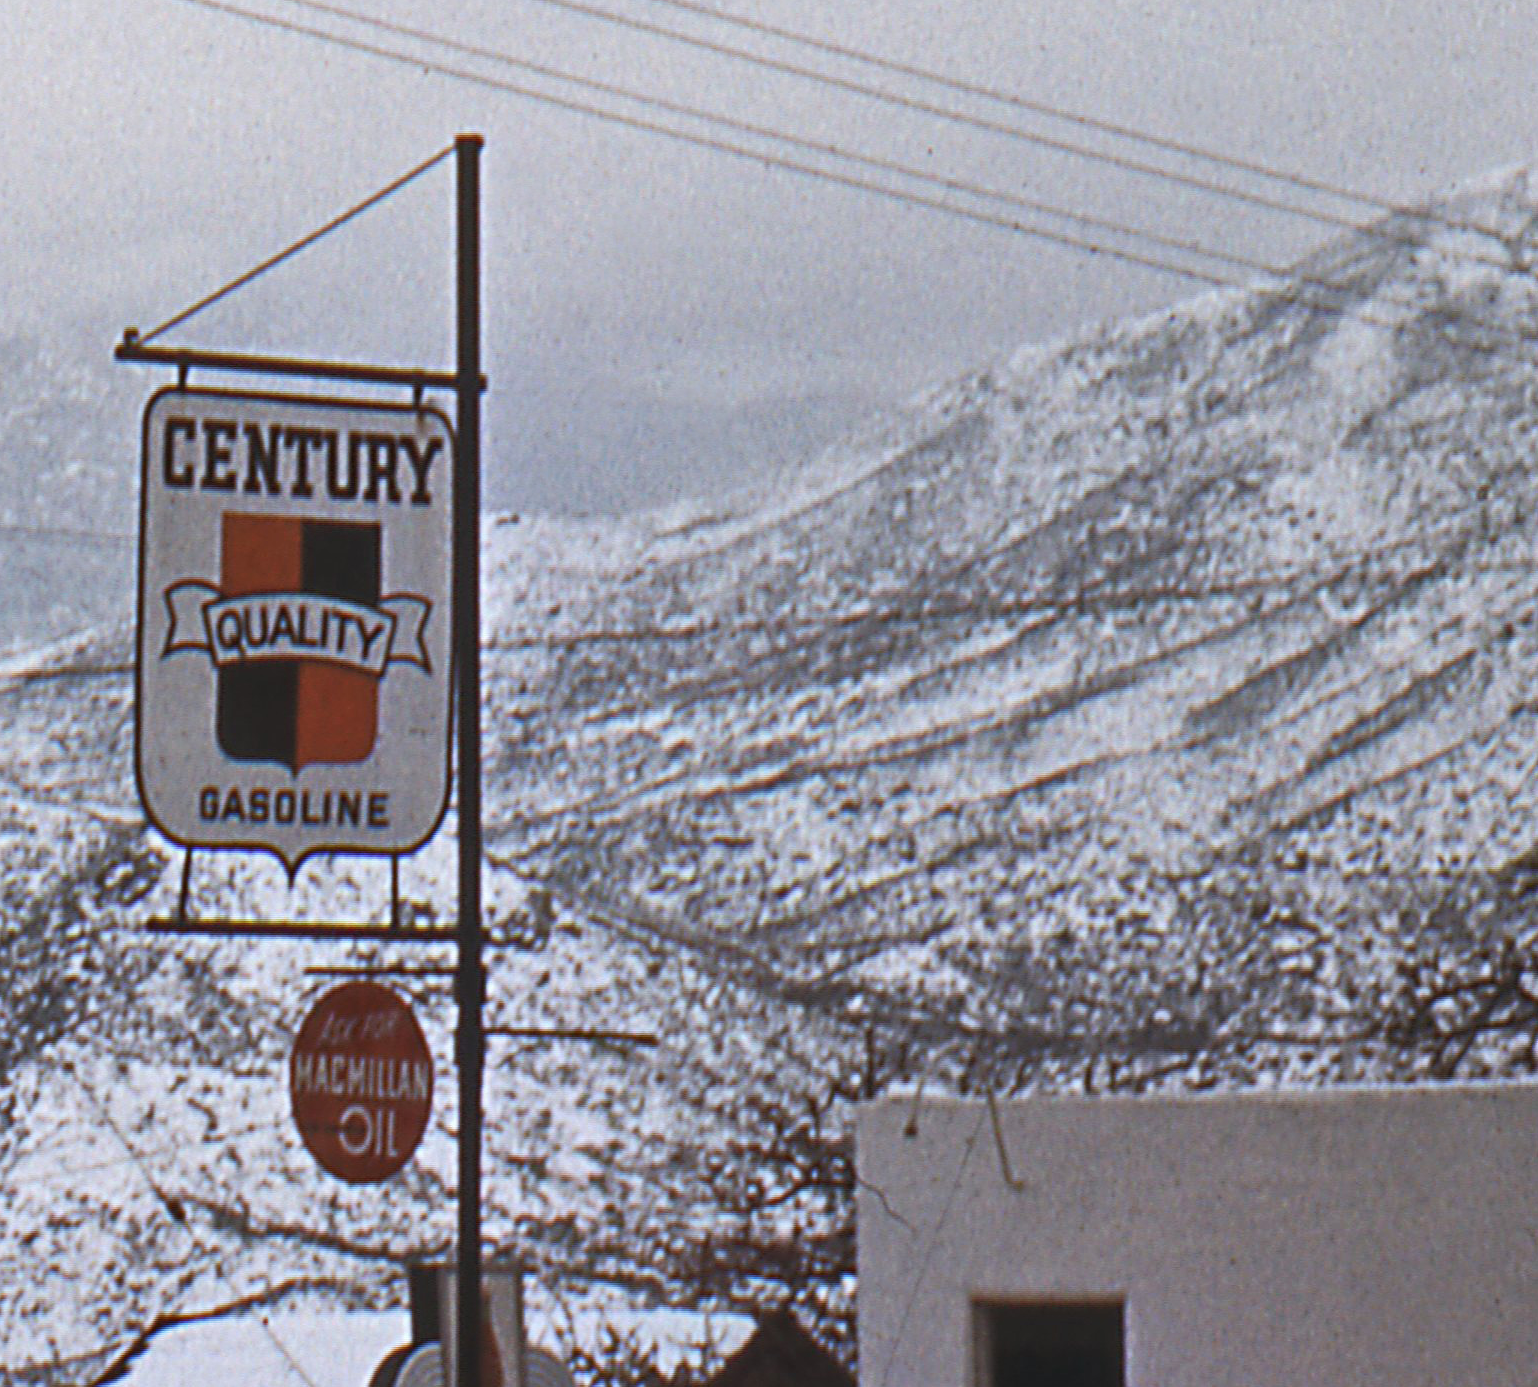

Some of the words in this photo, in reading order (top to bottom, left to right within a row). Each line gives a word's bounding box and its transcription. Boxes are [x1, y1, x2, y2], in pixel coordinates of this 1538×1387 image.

[162, 417, 442, 506] CENTURY
[215, 603, 384, 661] QUALITY
[199, 785, 389, 827] GASOLINE
[294, 1053, 430, 1099] MACMILLAN
[339, 1104, 399, 1157] OIL
